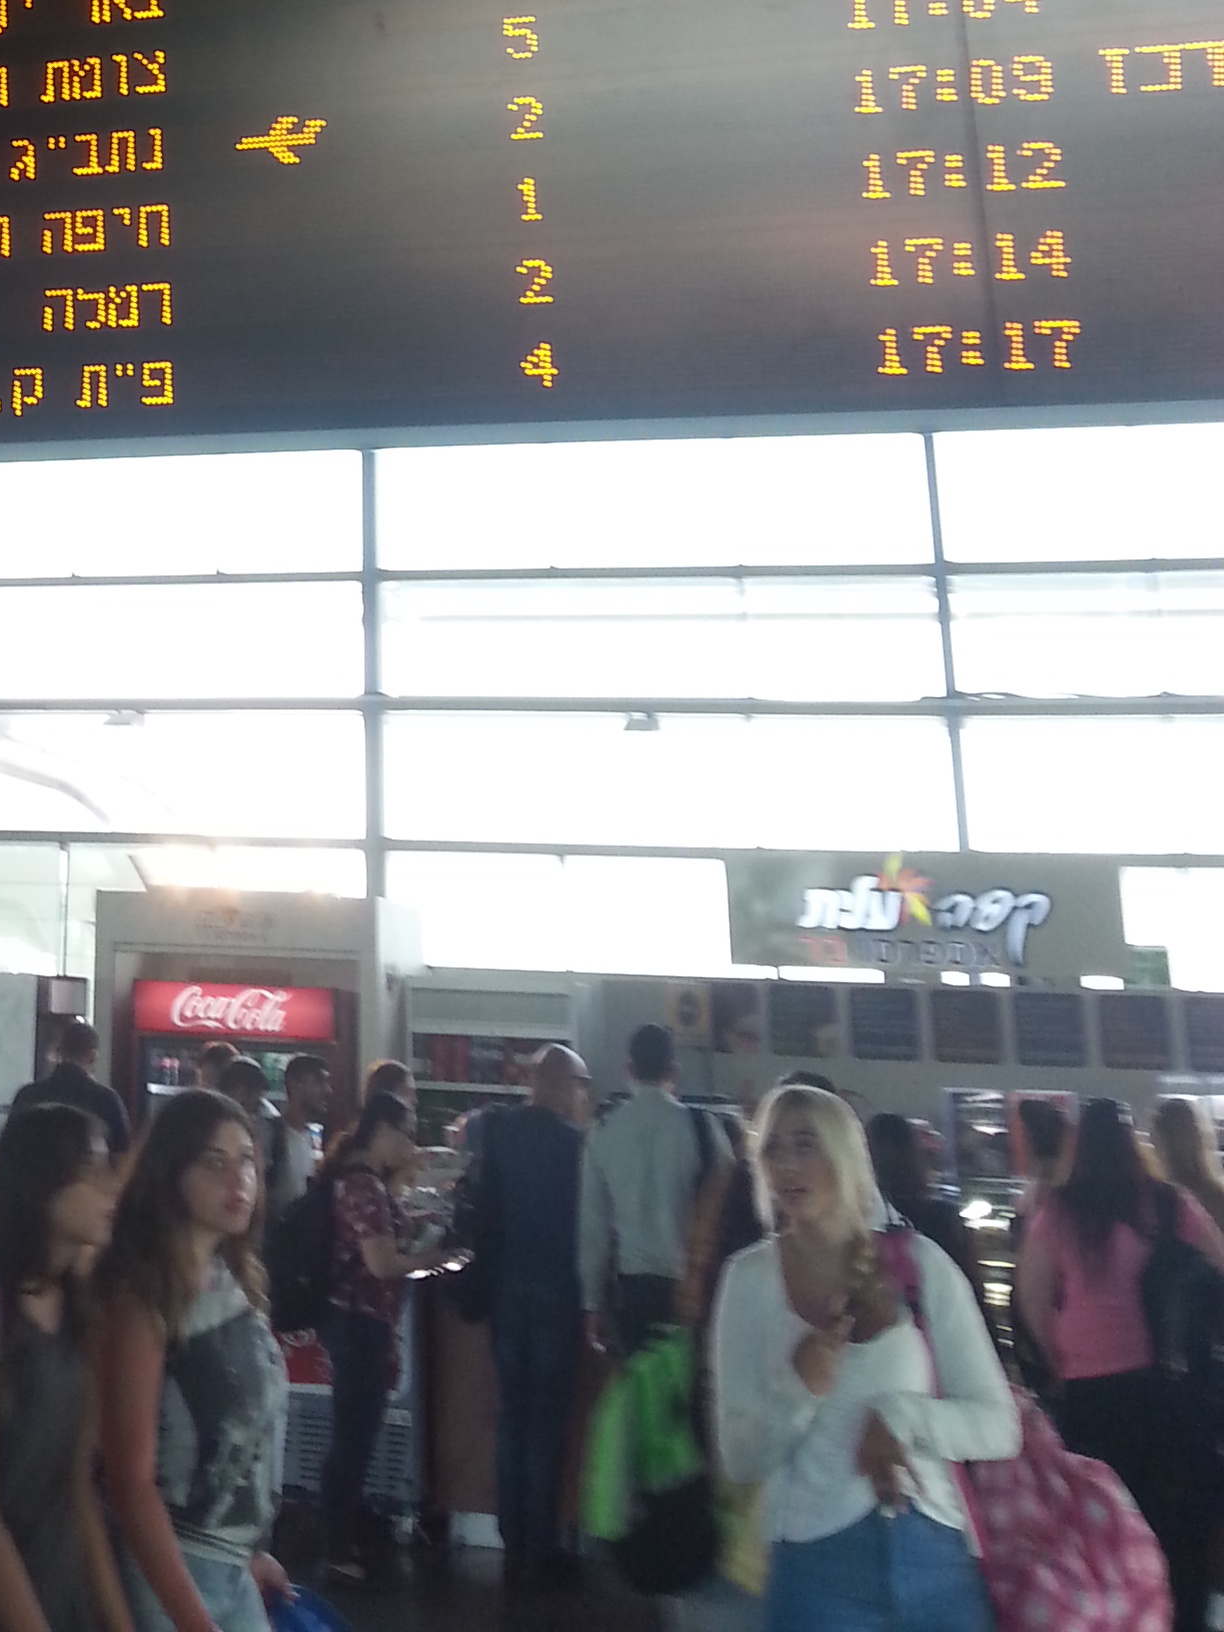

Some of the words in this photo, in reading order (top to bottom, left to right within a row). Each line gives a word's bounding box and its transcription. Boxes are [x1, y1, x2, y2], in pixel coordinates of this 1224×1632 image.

[38, 49, 167, 104] צומת
[854, 54, 1054, 115] 17:09
[506, 96, 544, 142] 2
[862, 141, 1067, 201] 17:12
[41, 203, 171, 256] חיפה
[869, 229, 1072, 288] 17:14
[41, 281, 173, 333] רמלה
[876, 318, 1082, 376] 17:17
